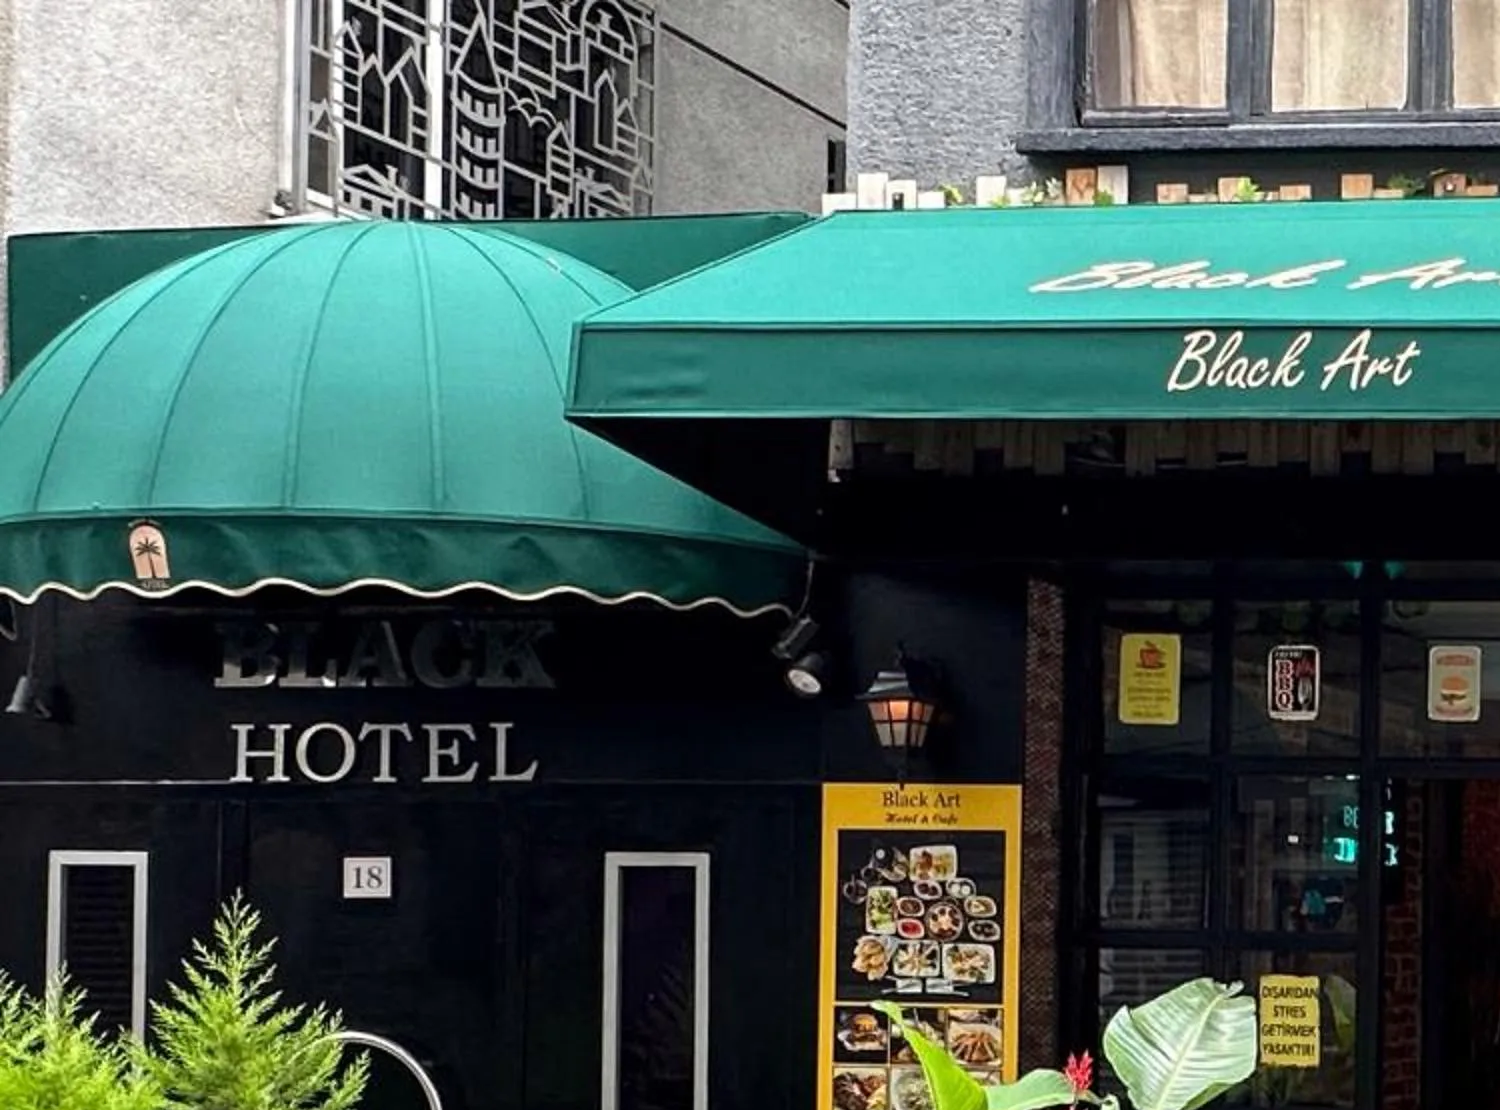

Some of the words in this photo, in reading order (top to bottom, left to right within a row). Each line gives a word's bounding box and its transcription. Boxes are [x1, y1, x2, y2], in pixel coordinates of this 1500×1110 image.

[1029, 260, 1346, 293] Black
[1167, 329, 1312, 392] Black
[1320, 328, 1421, 390] Art
[213, 620, 555, 690] BLACK
[229, 722, 539, 783] HOTEL
[883, 790, 929, 808] Black
[933, 791, 961, 808] Art
[353, 866, 382, 889] 18
[1273, 1004, 1307, 1018] STRES
